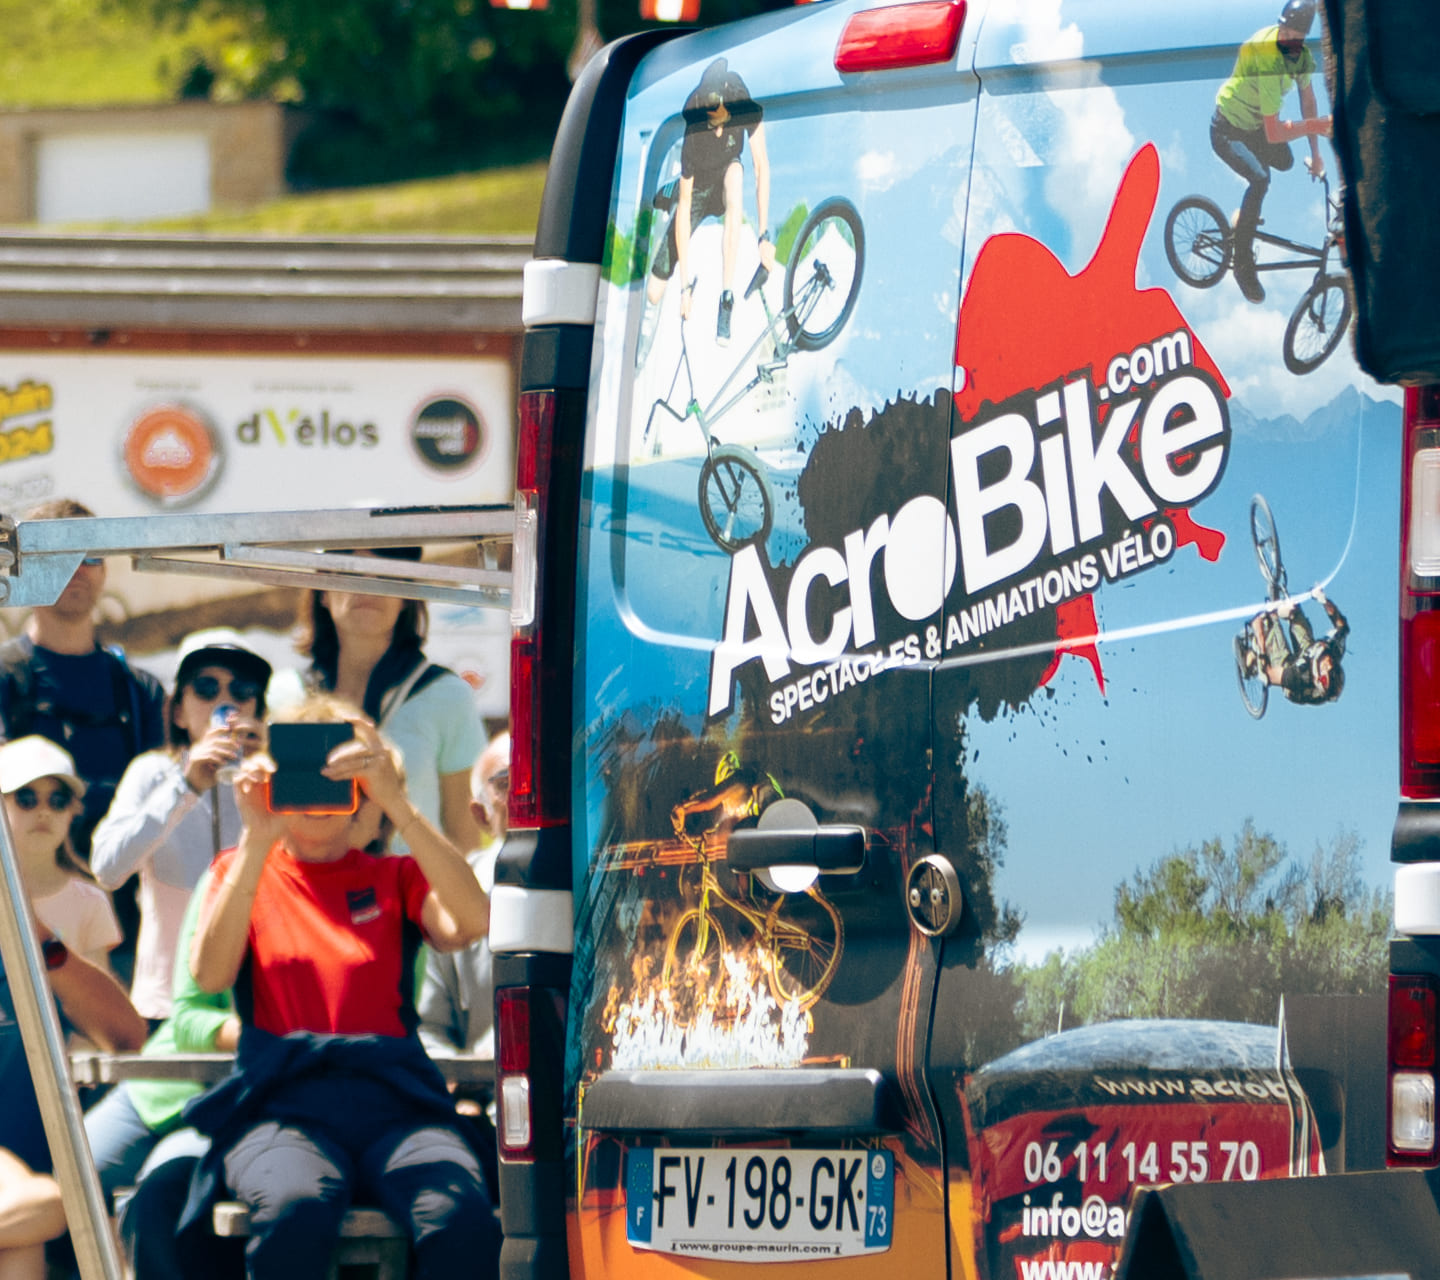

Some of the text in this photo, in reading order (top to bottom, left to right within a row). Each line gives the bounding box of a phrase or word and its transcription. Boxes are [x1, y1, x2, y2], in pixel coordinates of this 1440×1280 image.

[1100, 328, 1191, 404] .com
[708, 373, 1227, 716] AcroBike
[769, 523, 1174, 726] SPECTACLES & ANIMATIONS VÉLO
[636, 1155, 887, 1237] F FV-198-GK 73
[1023, 1140, 1260, 1183] 06 11 14 55 70
[679, 1241, 832, 1255] www.groupe-maurin.com
